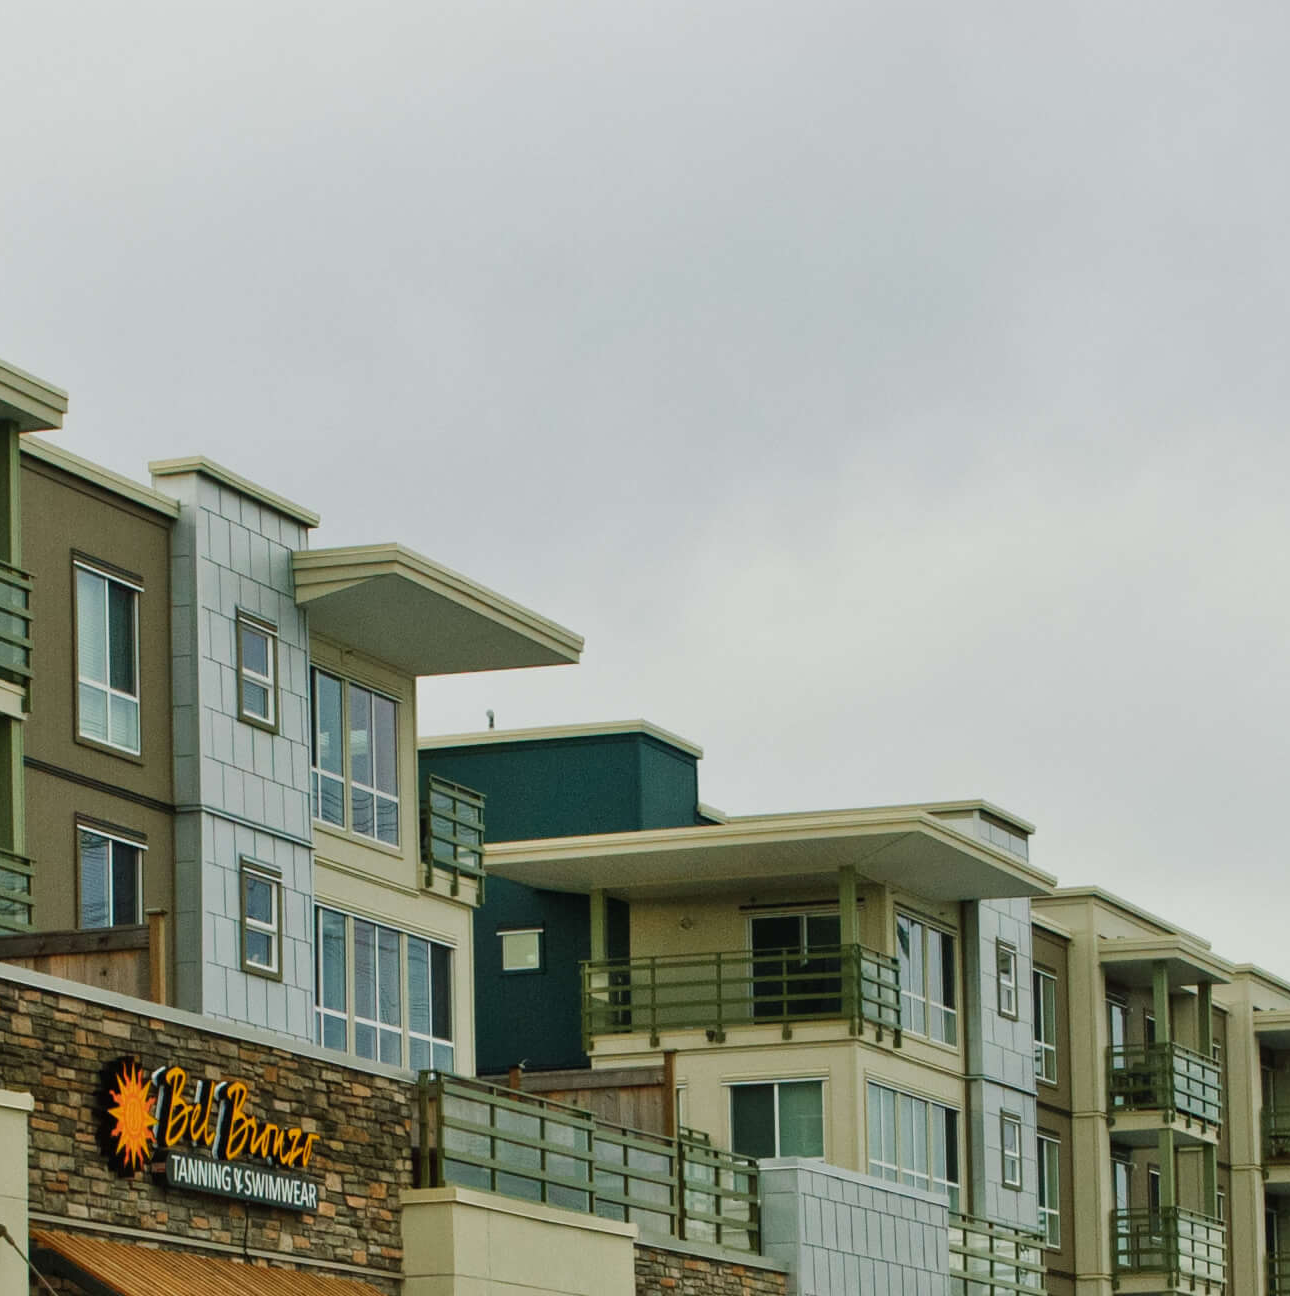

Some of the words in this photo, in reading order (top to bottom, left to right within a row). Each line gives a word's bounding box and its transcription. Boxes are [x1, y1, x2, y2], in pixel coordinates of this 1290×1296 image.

[164, 1066, 216, 1147] Bel
[226, 1082, 321, 1168] Bronzo
[171, 1155, 231, 1191] TANNING
[244, 1168, 317, 1209] SWIMWEAR
